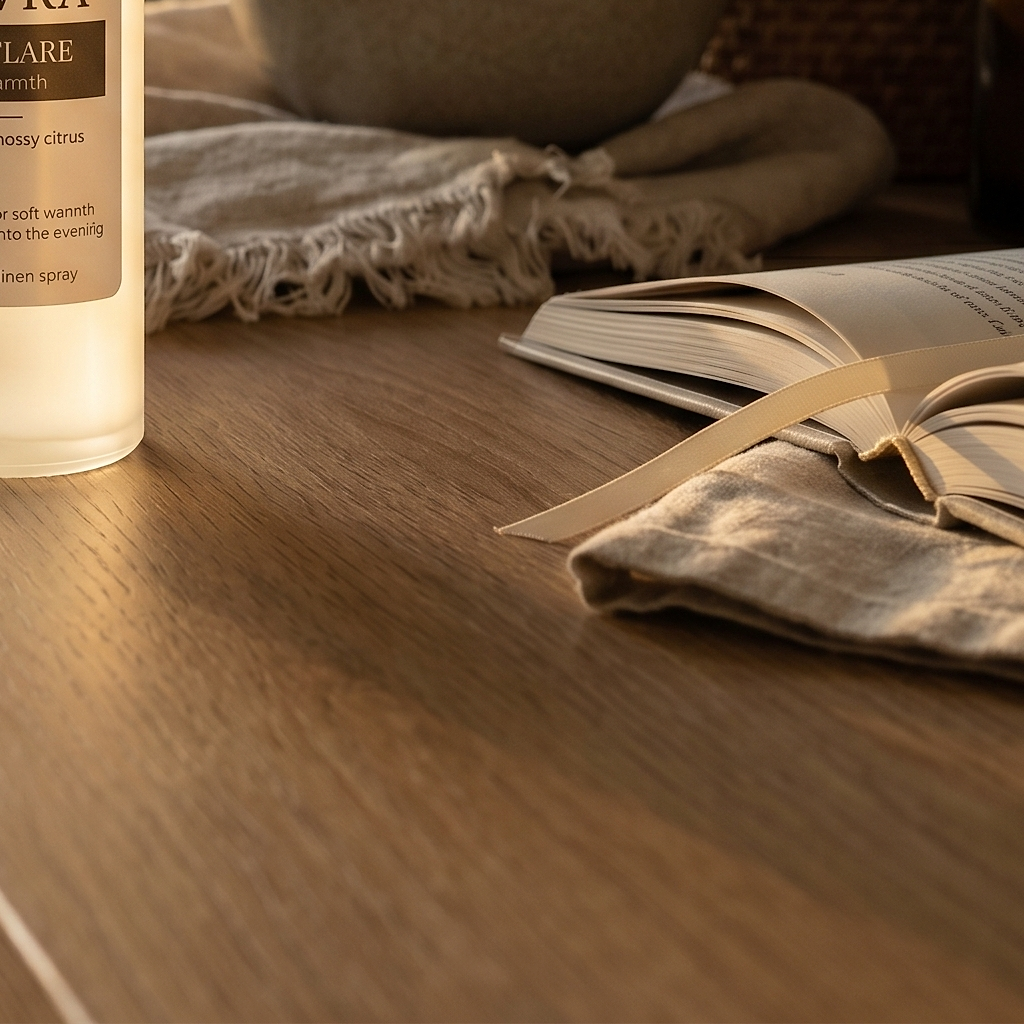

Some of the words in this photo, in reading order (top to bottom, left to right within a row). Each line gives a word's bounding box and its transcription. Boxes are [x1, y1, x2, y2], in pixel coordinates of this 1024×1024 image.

[43, 130, 85, 145] citrus
[12, 206, 40, 221] soft
[25, 226, 50, 241] the
[39, 269, 79, 286] spray
